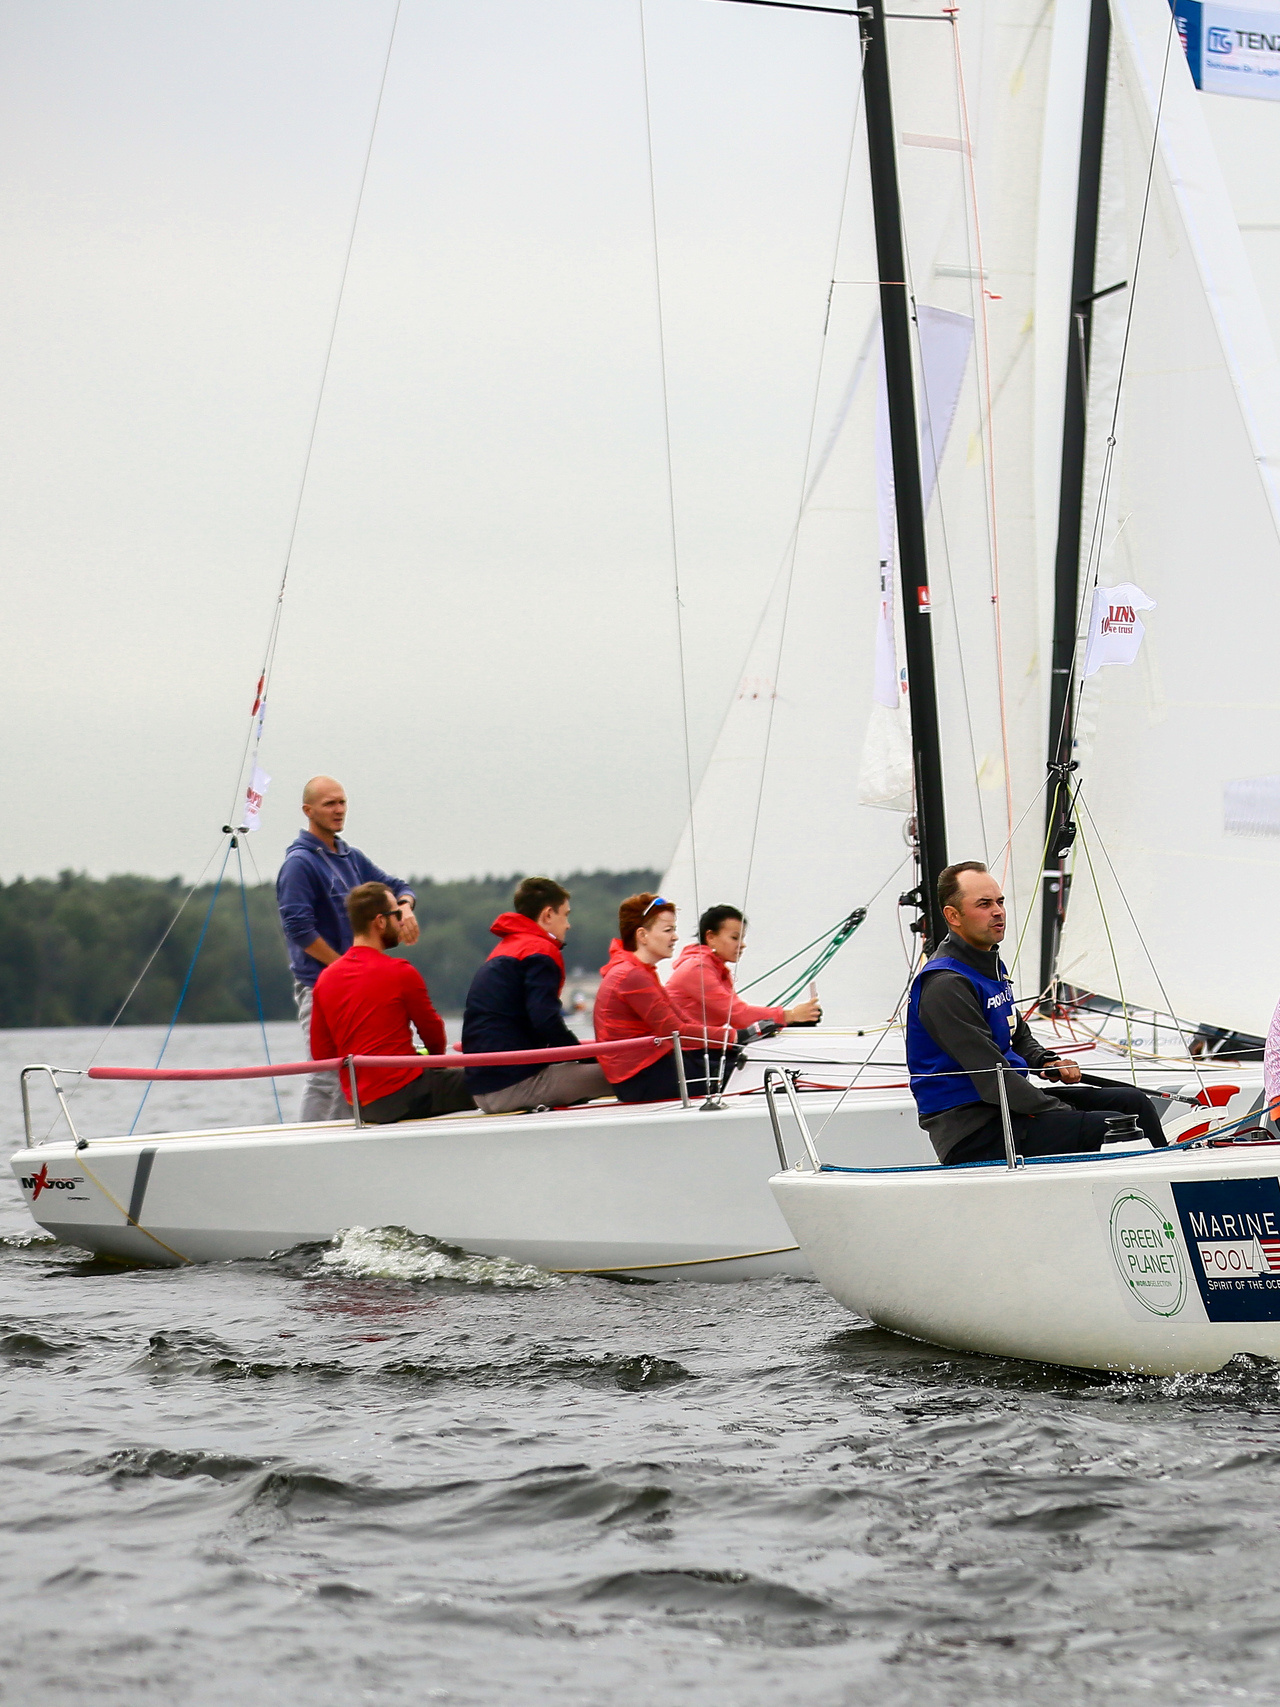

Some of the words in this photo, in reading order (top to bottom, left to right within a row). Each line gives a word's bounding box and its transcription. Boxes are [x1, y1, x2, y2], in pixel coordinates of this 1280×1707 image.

[1189, 1211, 1279, 1238] MARINE
[1120, 1229, 1164, 1248] GREEN
[1128, 1254, 1176, 1274] PLANET
[1202, 1249, 1254, 1271] POOL
